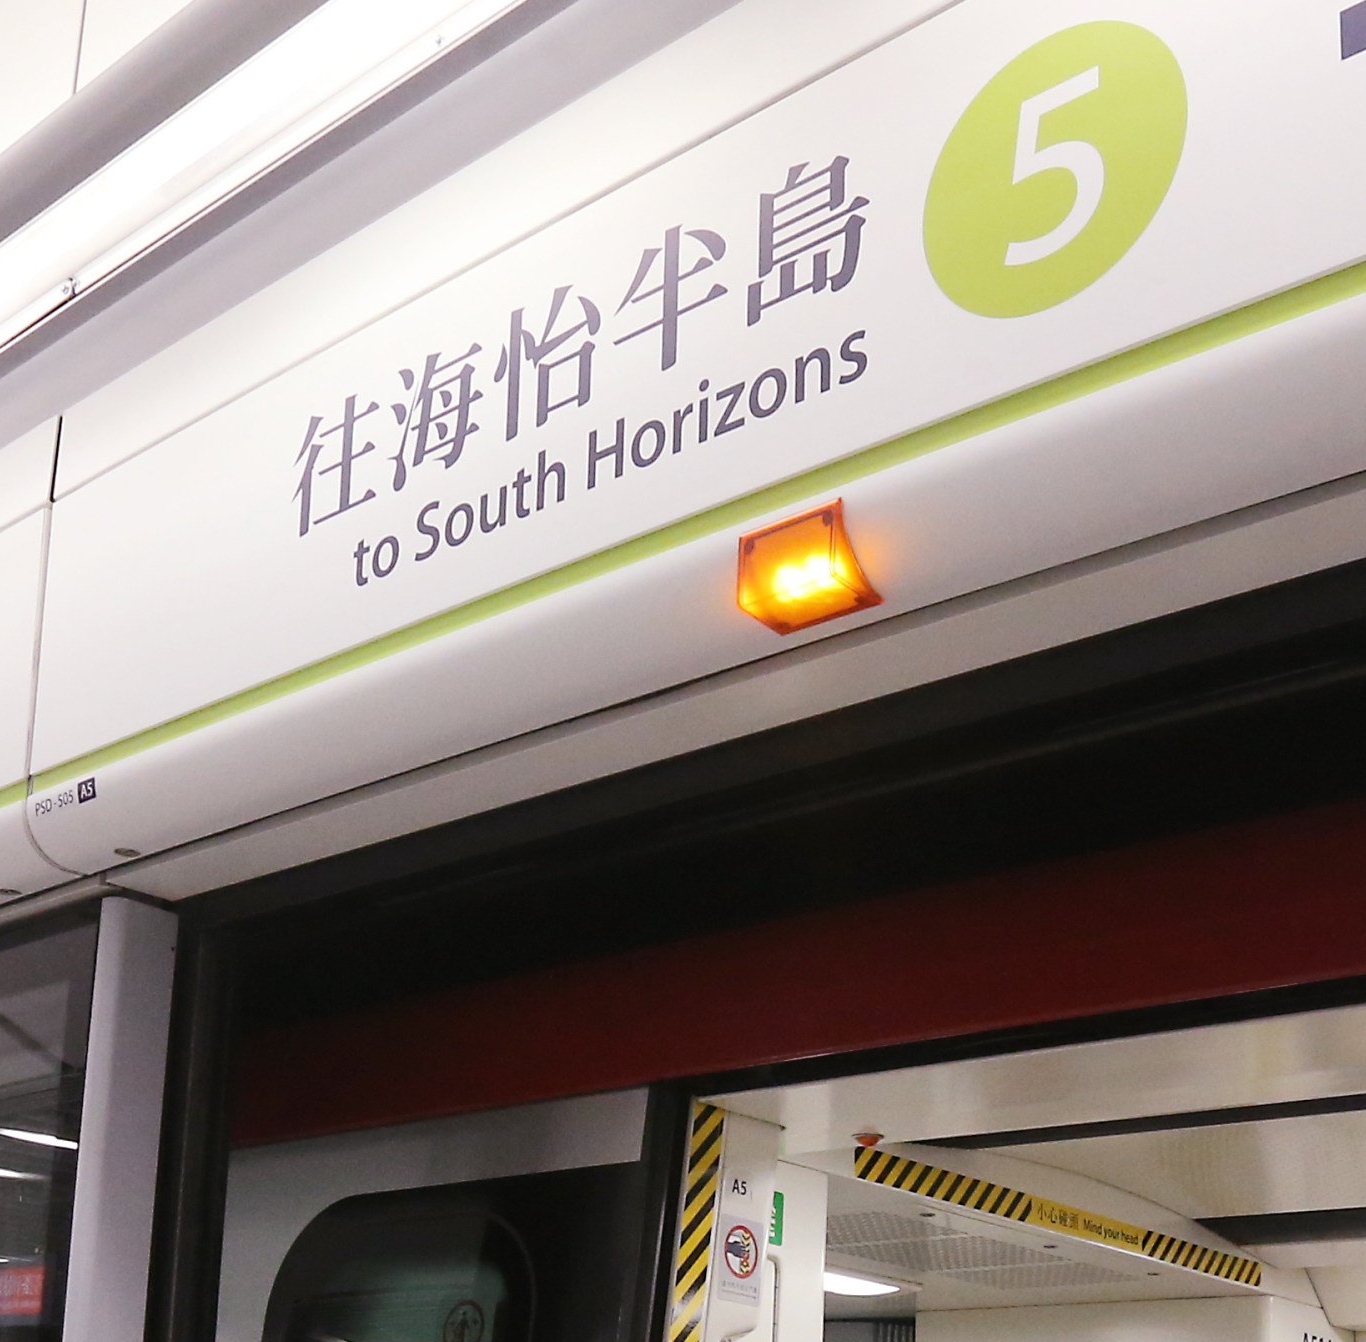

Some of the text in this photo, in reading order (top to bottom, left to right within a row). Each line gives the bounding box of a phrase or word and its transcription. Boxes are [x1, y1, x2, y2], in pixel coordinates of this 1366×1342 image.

[1003, 64, 1106, 268] 5
[291, 155, 870, 536] 往海怡半島
[353, 329, 868, 587] to South Horizons
[80, 781, 94, 799] A5
[731, 1179, 747, 1196] A5
[1083, 1218, 1138, 1245] Mind your head
